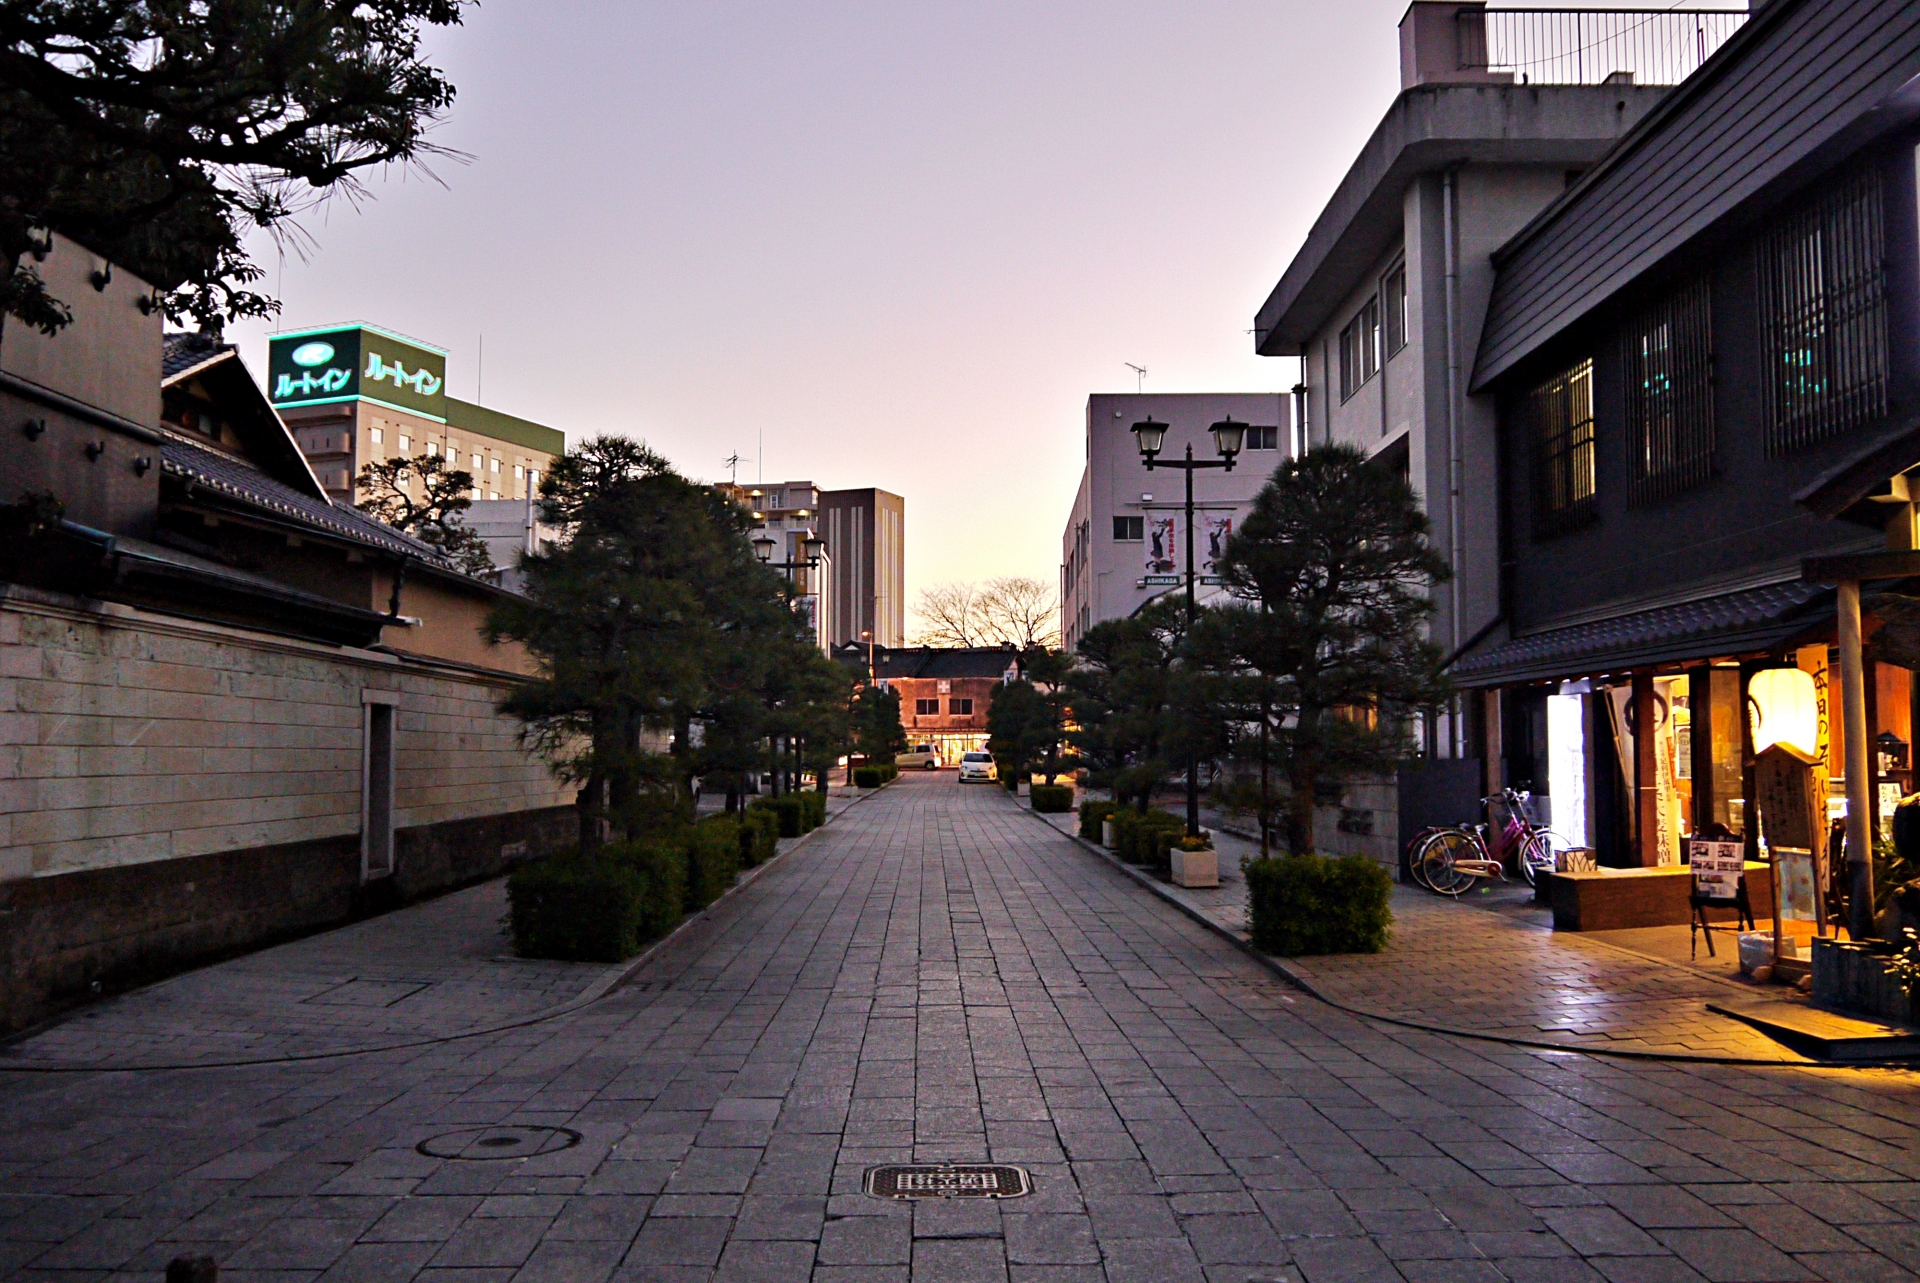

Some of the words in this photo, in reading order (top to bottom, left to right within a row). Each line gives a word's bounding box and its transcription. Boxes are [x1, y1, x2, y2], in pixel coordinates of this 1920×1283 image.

[275, 368, 352, 398] ルートイン
[365, 352, 441, 395] ルートイン
